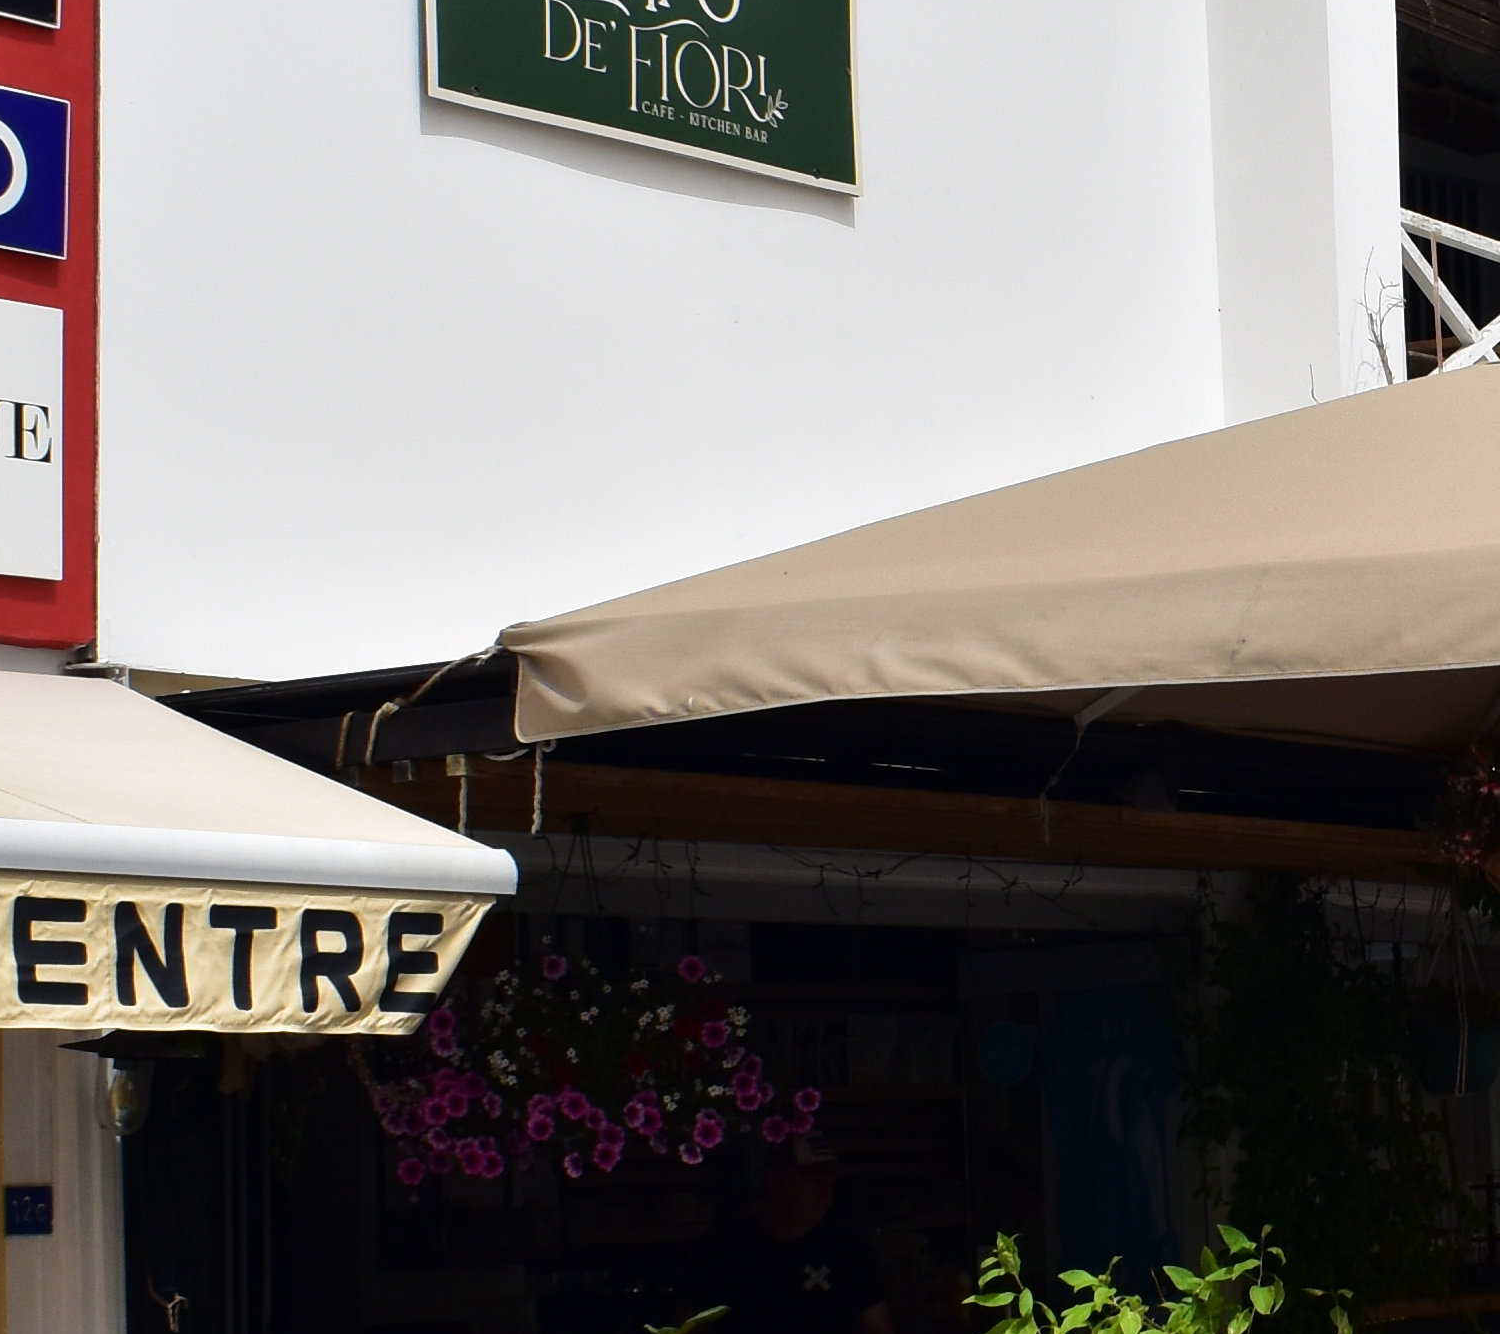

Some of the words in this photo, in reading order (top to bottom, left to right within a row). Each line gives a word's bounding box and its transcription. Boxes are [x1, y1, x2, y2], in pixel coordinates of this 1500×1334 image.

[628, 19, 769, 122] FIORI
[642, 101, 675, 120] CAFE
[689, 112, 741, 136] KITCHEN
[745, 126, 768, 144] BAR
